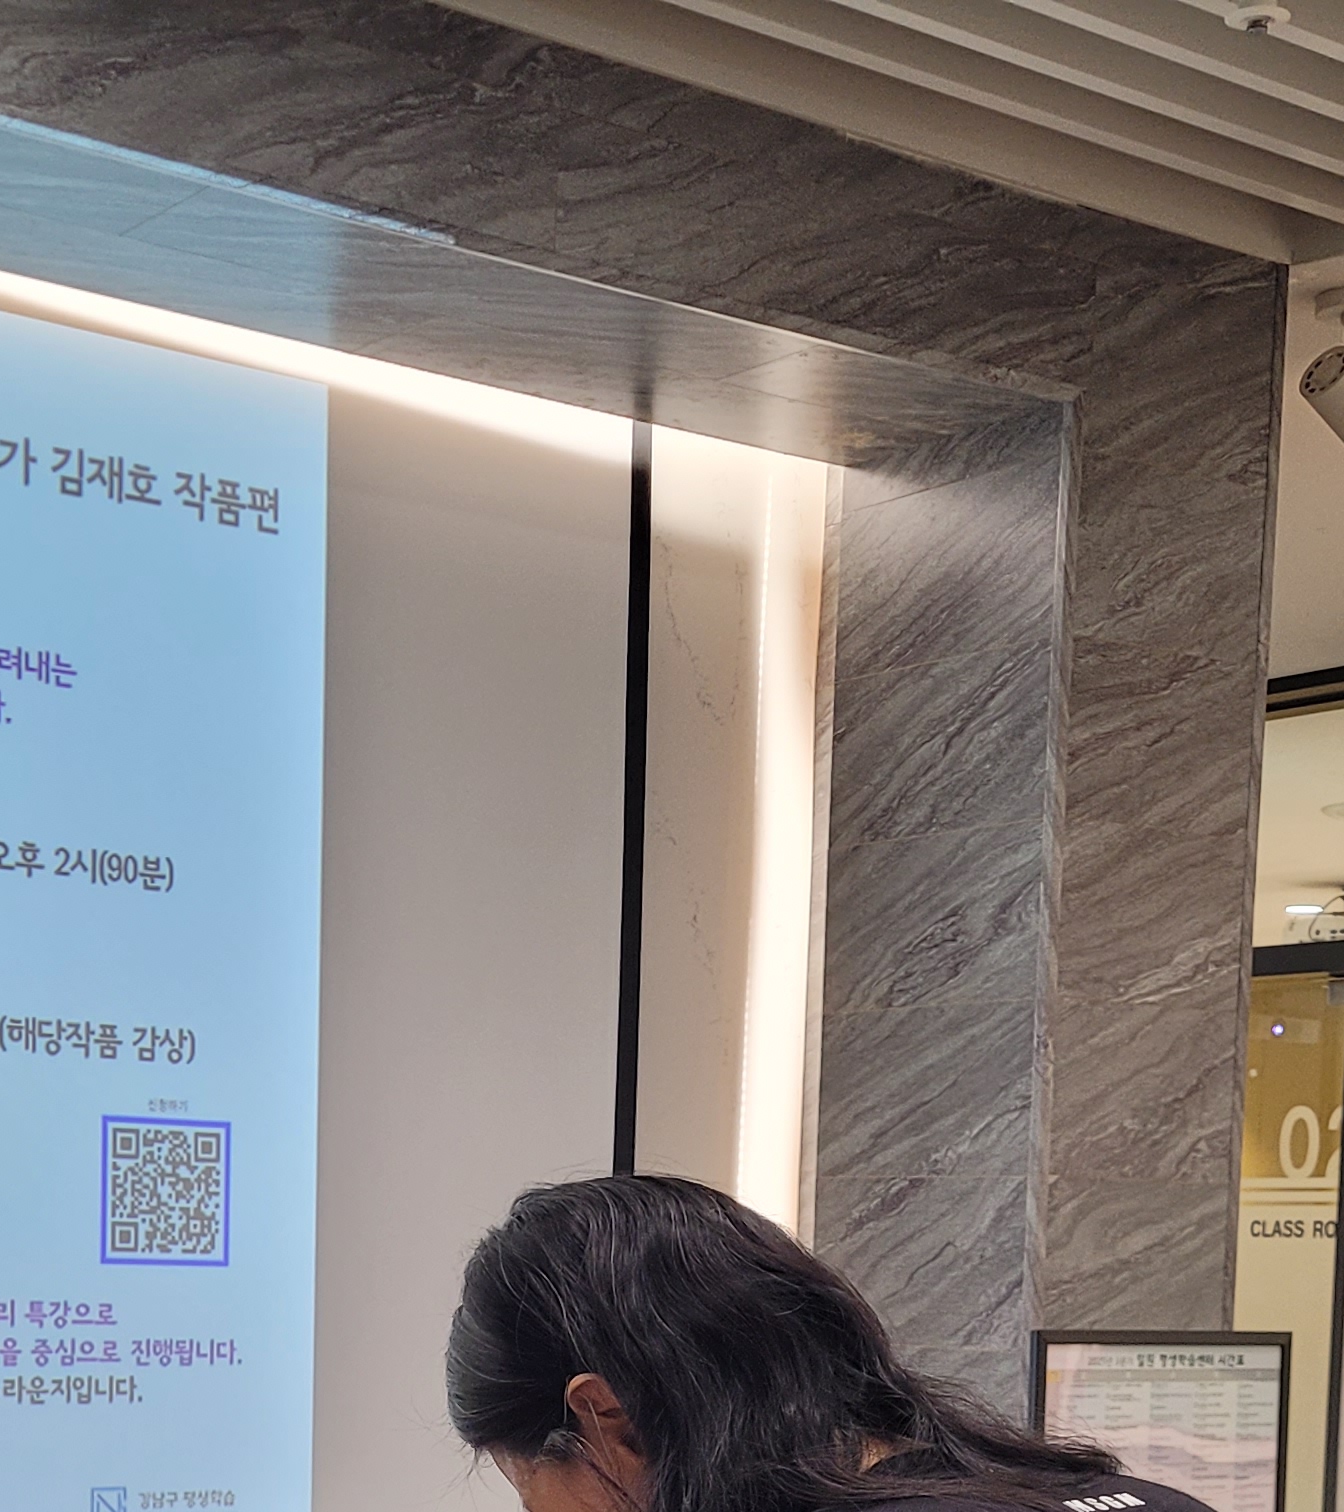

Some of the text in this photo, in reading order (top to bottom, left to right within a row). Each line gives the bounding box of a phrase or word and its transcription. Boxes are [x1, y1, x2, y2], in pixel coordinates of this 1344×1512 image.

[51, 447, 162, 506] 김재호
[174, 472, 279, 535] 작품편
[54, 847, 174, 892] 2시(90분)
[132, 1026, 196, 1065] 감상)
[1250, 1219, 1305, 1238] CLASS
[25, 1300, 117, 1329] 특강으로
[31, 1338, 121, 1368] 중심으로
[131, 1338, 242, 1368] 진행됩니다.
[3, 1375, 143, 1405] 라운지입니다.
[138, 1489, 236, 1510] 강남구 평생학습
